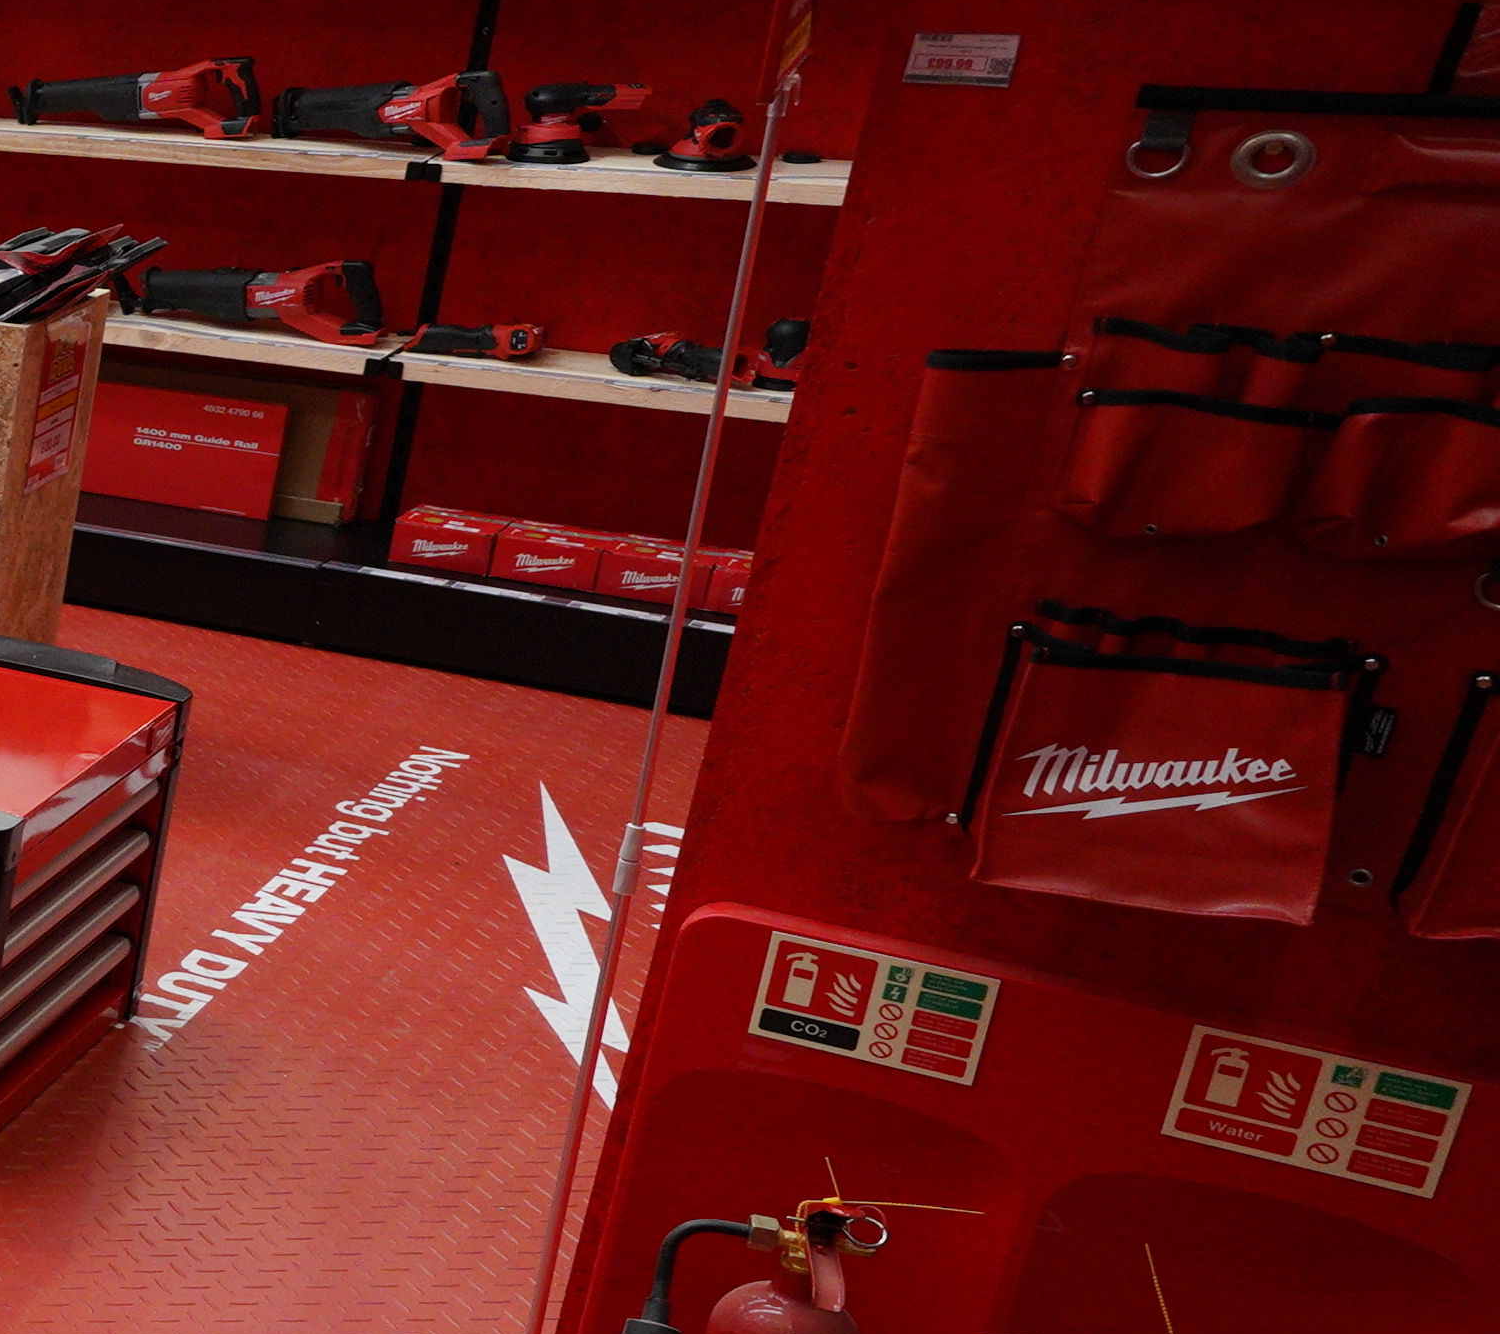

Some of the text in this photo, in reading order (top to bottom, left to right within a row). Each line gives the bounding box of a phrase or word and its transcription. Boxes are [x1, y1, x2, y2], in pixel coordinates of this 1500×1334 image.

[255, 287, 296, 304] Milwaukee
[135, 426, 260, 450] 1400 mm Guide Rail
[412, 539, 470, 556] Milwaukee
[514, 553, 576, 572] Milwaukee
[1015, 743, 1297, 798] Milwaukee
[336, 745, 470, 840] Nothing
[211, 857, 348, 955] HEAVY
[1207, 1119, 1266, 1143] Water
